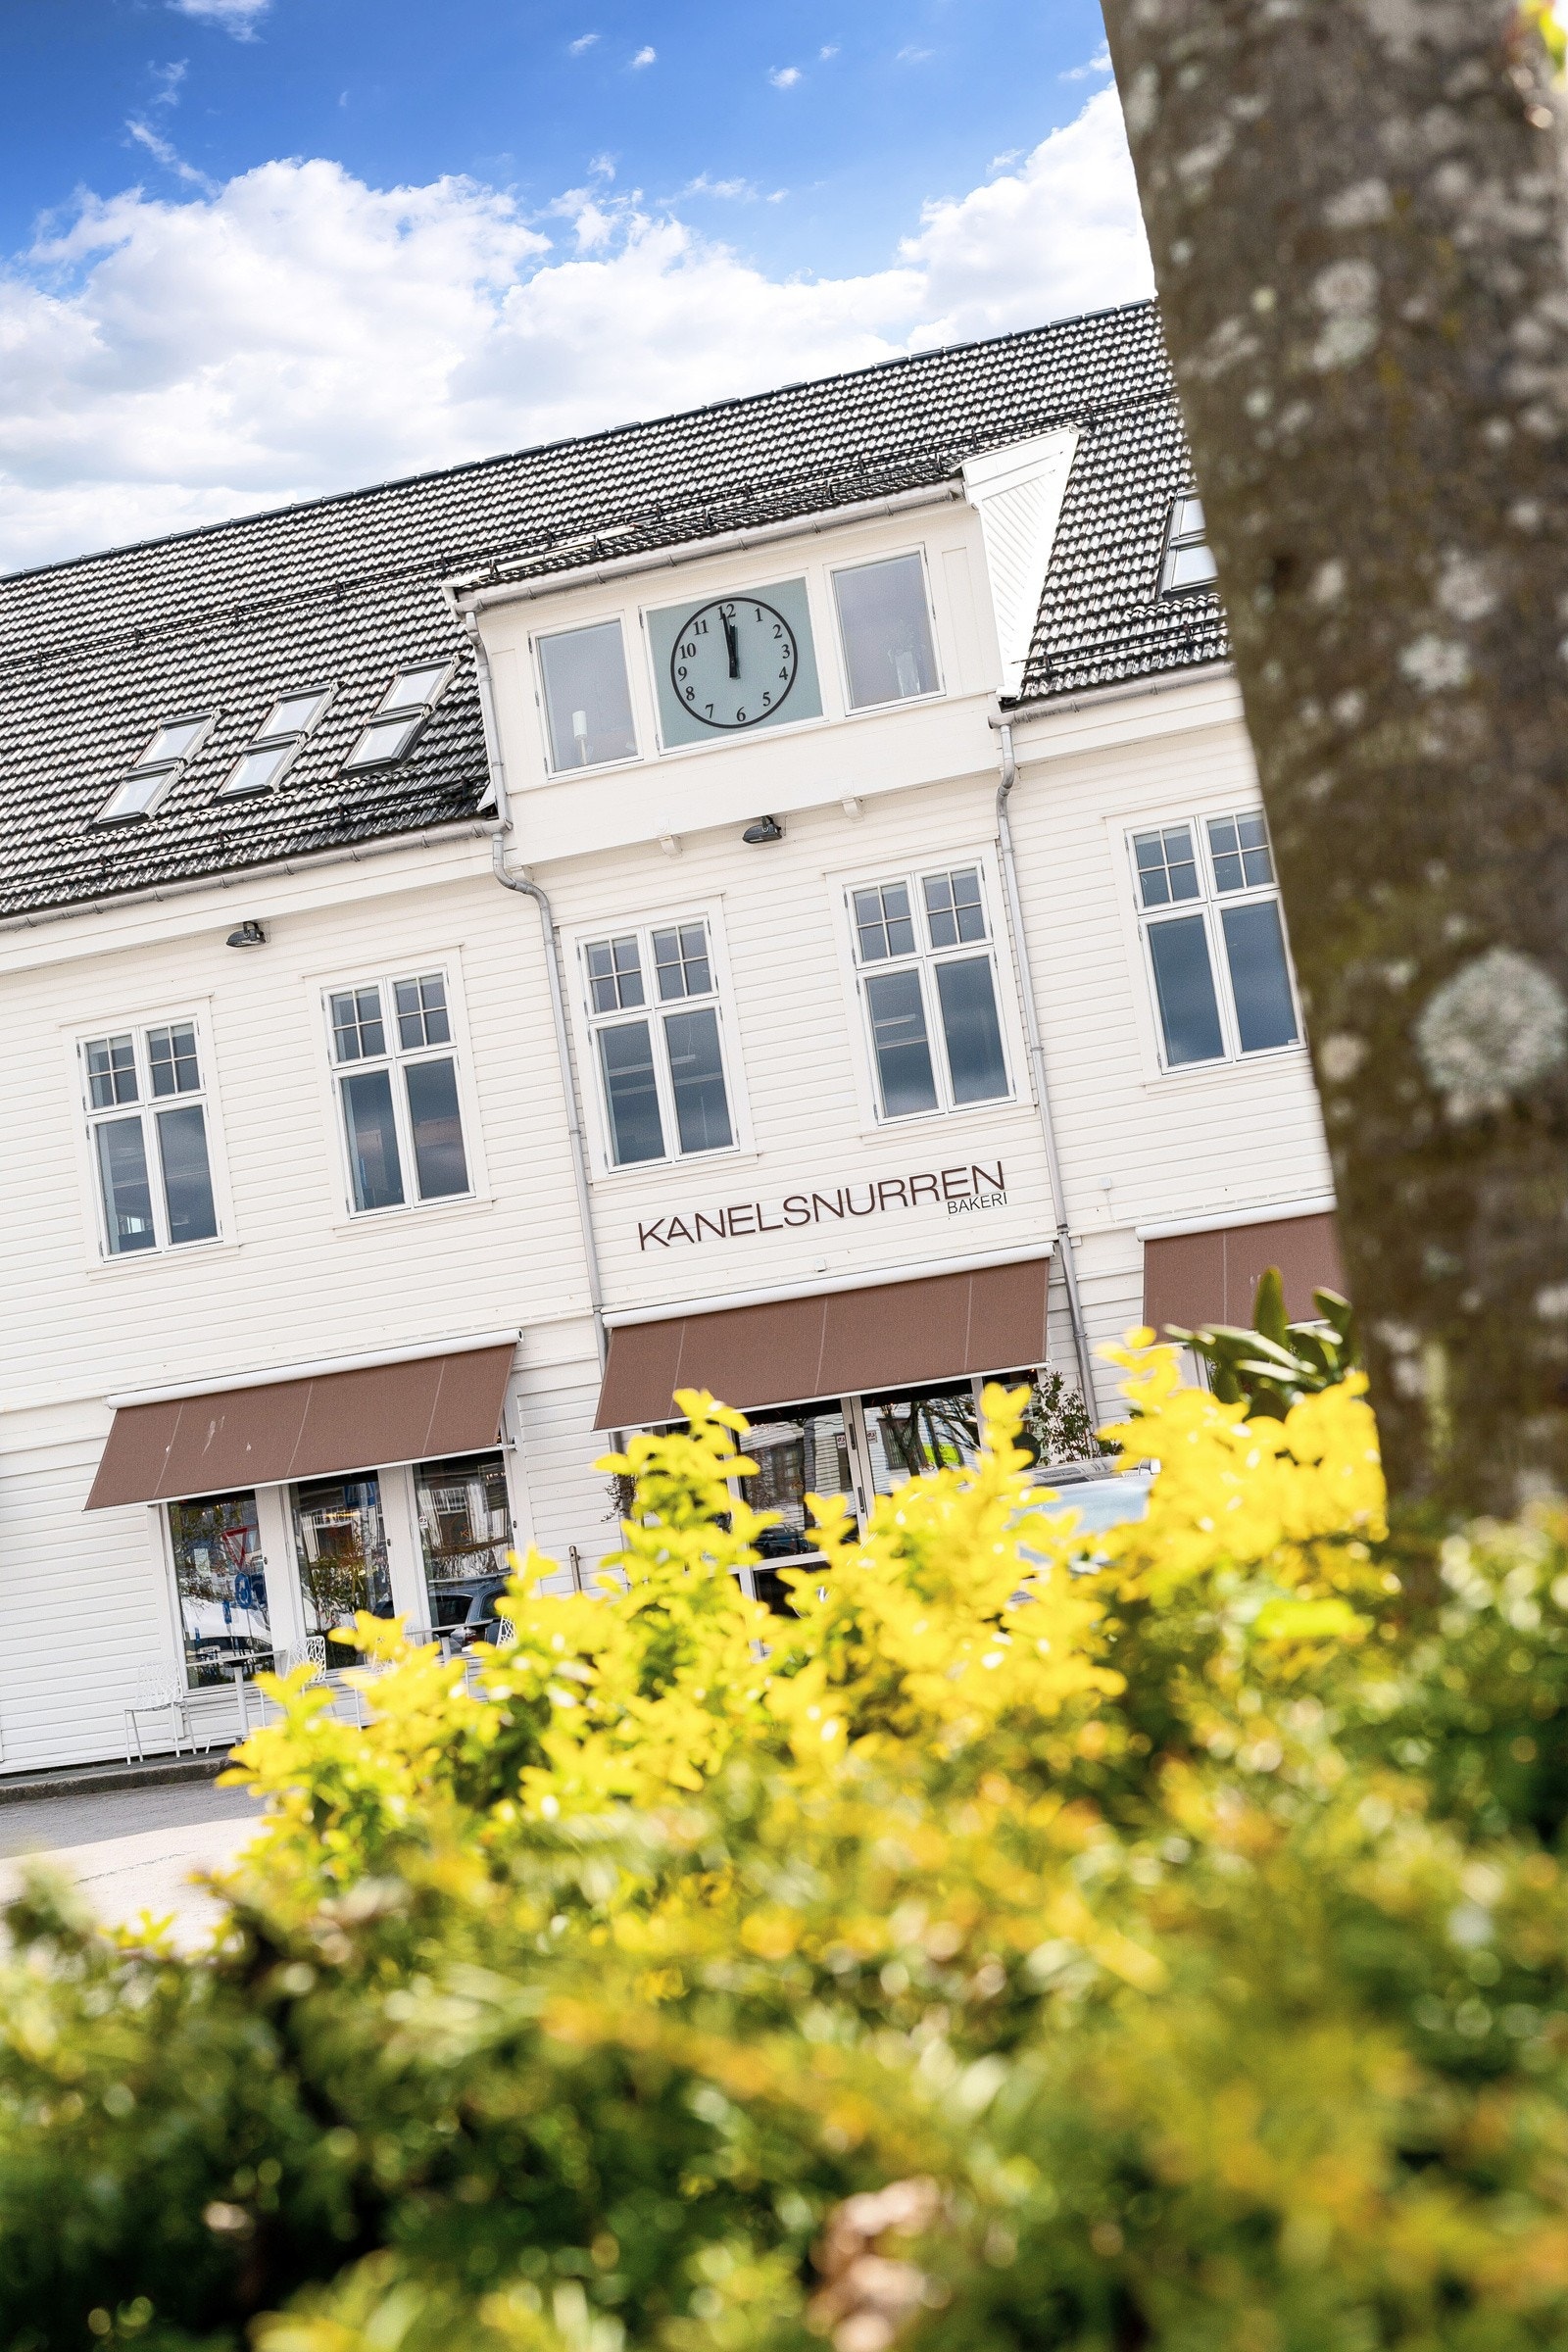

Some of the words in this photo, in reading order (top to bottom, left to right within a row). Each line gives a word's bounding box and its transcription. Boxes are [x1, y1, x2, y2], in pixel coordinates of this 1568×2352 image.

[717, 603, 736, 620] 12
[755, 608, 762, 622] 1
[693, 619, 709, 635] 11
[773, 624, 782, 639] 2
[679, 643, 696, 660] 10
[781, 644, 790, 659] 3
[677, 666, 687, 681] 9
[779, 666, 788, 680] 4
[685, 686, 695, 701] 8
[762, 691, 771, 707] 5
[705, 703, 713, 718] 7
[736, 707, 746, 721] 6
[638, 1160, 1005, 1251] KANELSNURREN
[947, 1192, 1007, 1214] BAKERI
